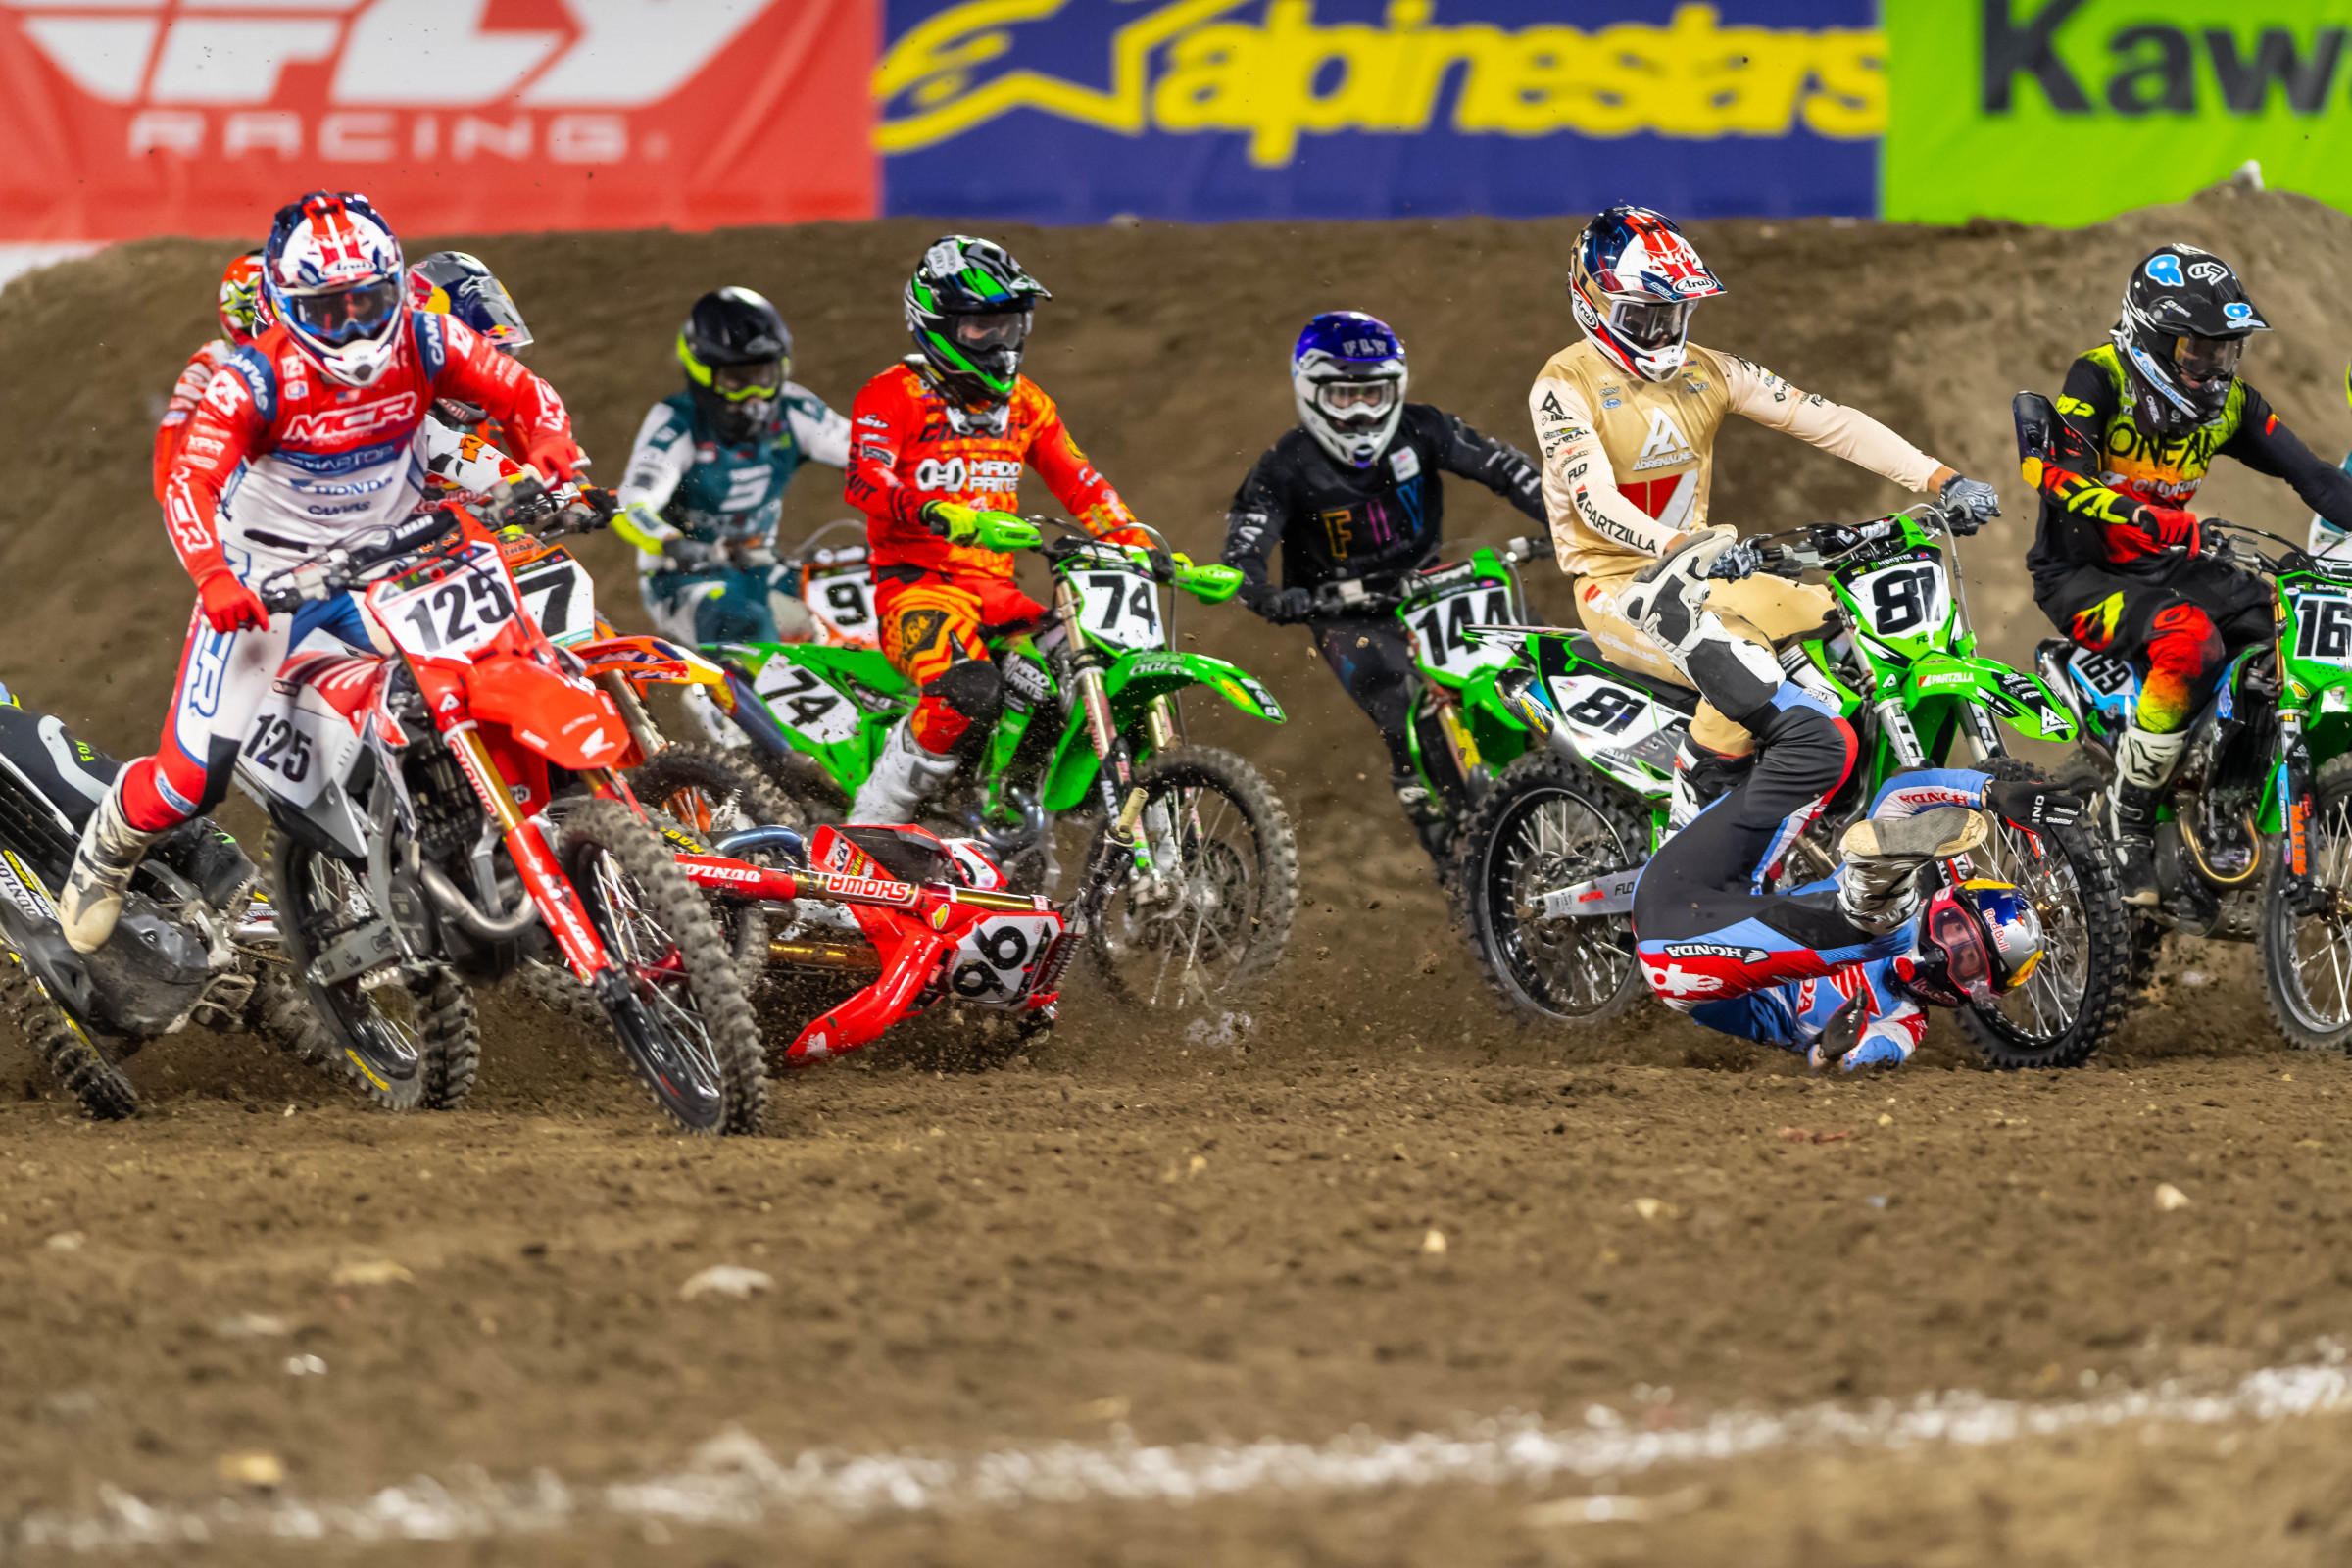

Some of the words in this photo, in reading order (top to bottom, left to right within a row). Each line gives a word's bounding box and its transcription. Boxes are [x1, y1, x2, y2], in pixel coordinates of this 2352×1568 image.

[1981, 0, 2352, 116] Kaw
[1152, 0, 1889, 166] alpinestars
[128, 111, 628, 162] RACING
[1682, 278, 1711, 290] Arai
[1573, 295, 1598, 326] Arai
[1342, 337, 1388, 356] FLY
[2140, 359, 2183, 407] OnlyFans
[281, 391, 418, 442] MCR
[968, 459, 1022, 477] MADD
[968, 476, 1019, 493] PARTS
[1568, 463, 1588, 484] FLO
[1632, 451, 1696, 471] ADRENALINE
[2132, 478, 2202, 498] OnlyFan
[1322, 474, 1425, 560] FLY
[1584, 500, 1657, 554] PARTZILLA
[1877, 554, 1914, 568] MONSTER
[404, 567, 514, 653] 125
[519, 564, 576, 638] 7
[825, 579, 878, 627] 9
[1089, 574, 1156, 635] 74
[1871, 565, 1941, 636] 81
[1415, 589, 1515, 668] 144
[2297, 599, 2352, 658] 16
[1931, 672, 1974, 686] PARTZILLA
[2075, 651, 2132, 697] 169
[760, 668, 841, 729] 74
[1565, 686, 1648, 737] 81
[244, 713, 312, 783] 125
[1899, 790, 1969, 807] HONDA
[663, 828, 706, 856] DUN
[0, 858, 37, 917] DUNLO
[686, 862, 761, 883] DUNLO
[827, 875, 912, 901] SHOWA
[1665, 945, 1743, 959] HONDA
[1982, 907, 2003, 930] Red
[1993, 928, 2011, 953] Bull
[952, 925, 1028, 998] 96
